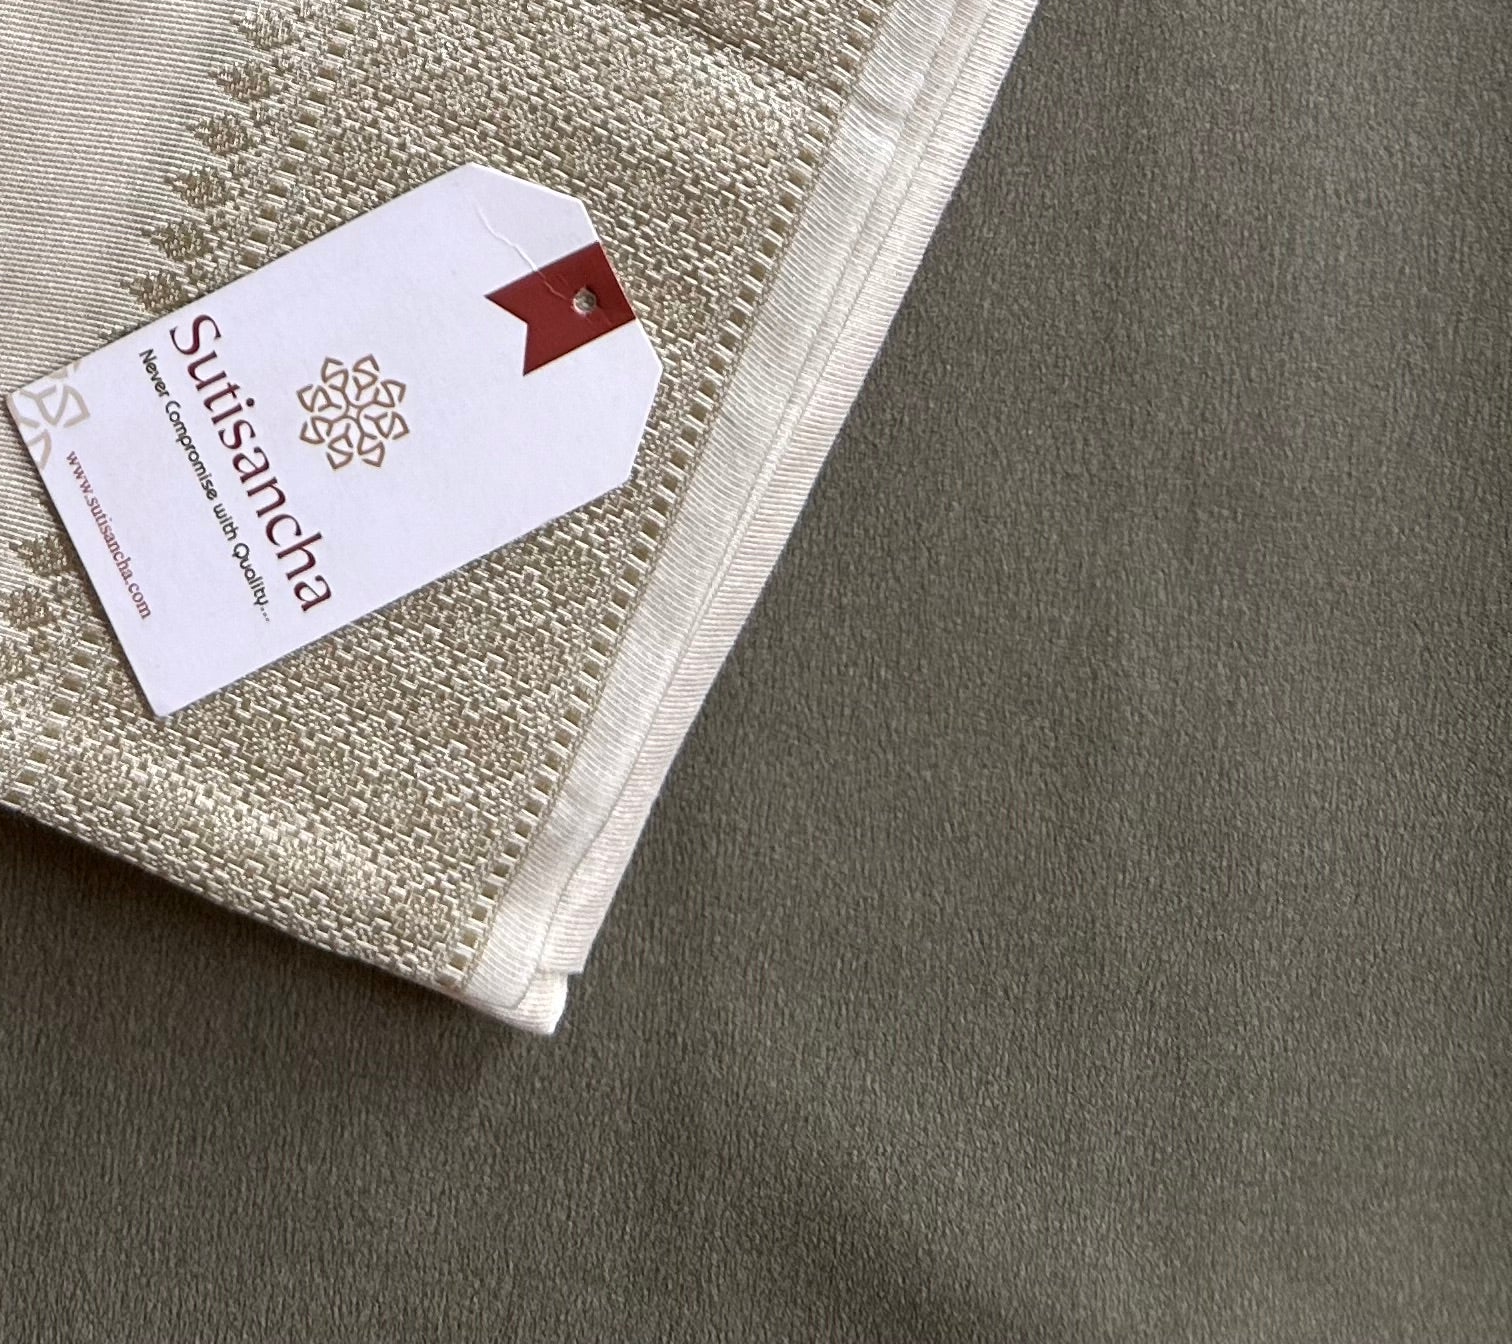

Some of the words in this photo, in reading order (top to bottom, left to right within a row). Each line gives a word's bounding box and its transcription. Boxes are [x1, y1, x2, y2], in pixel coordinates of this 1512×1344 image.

[65, 450, 151, 620] www.sutisancha.com
[138, 348, 170, 398] Never
[165, 400, 218, 501] Compromise
[213, 503, 238, 542] with
[169, 314, 332, 613] Sutisancha
